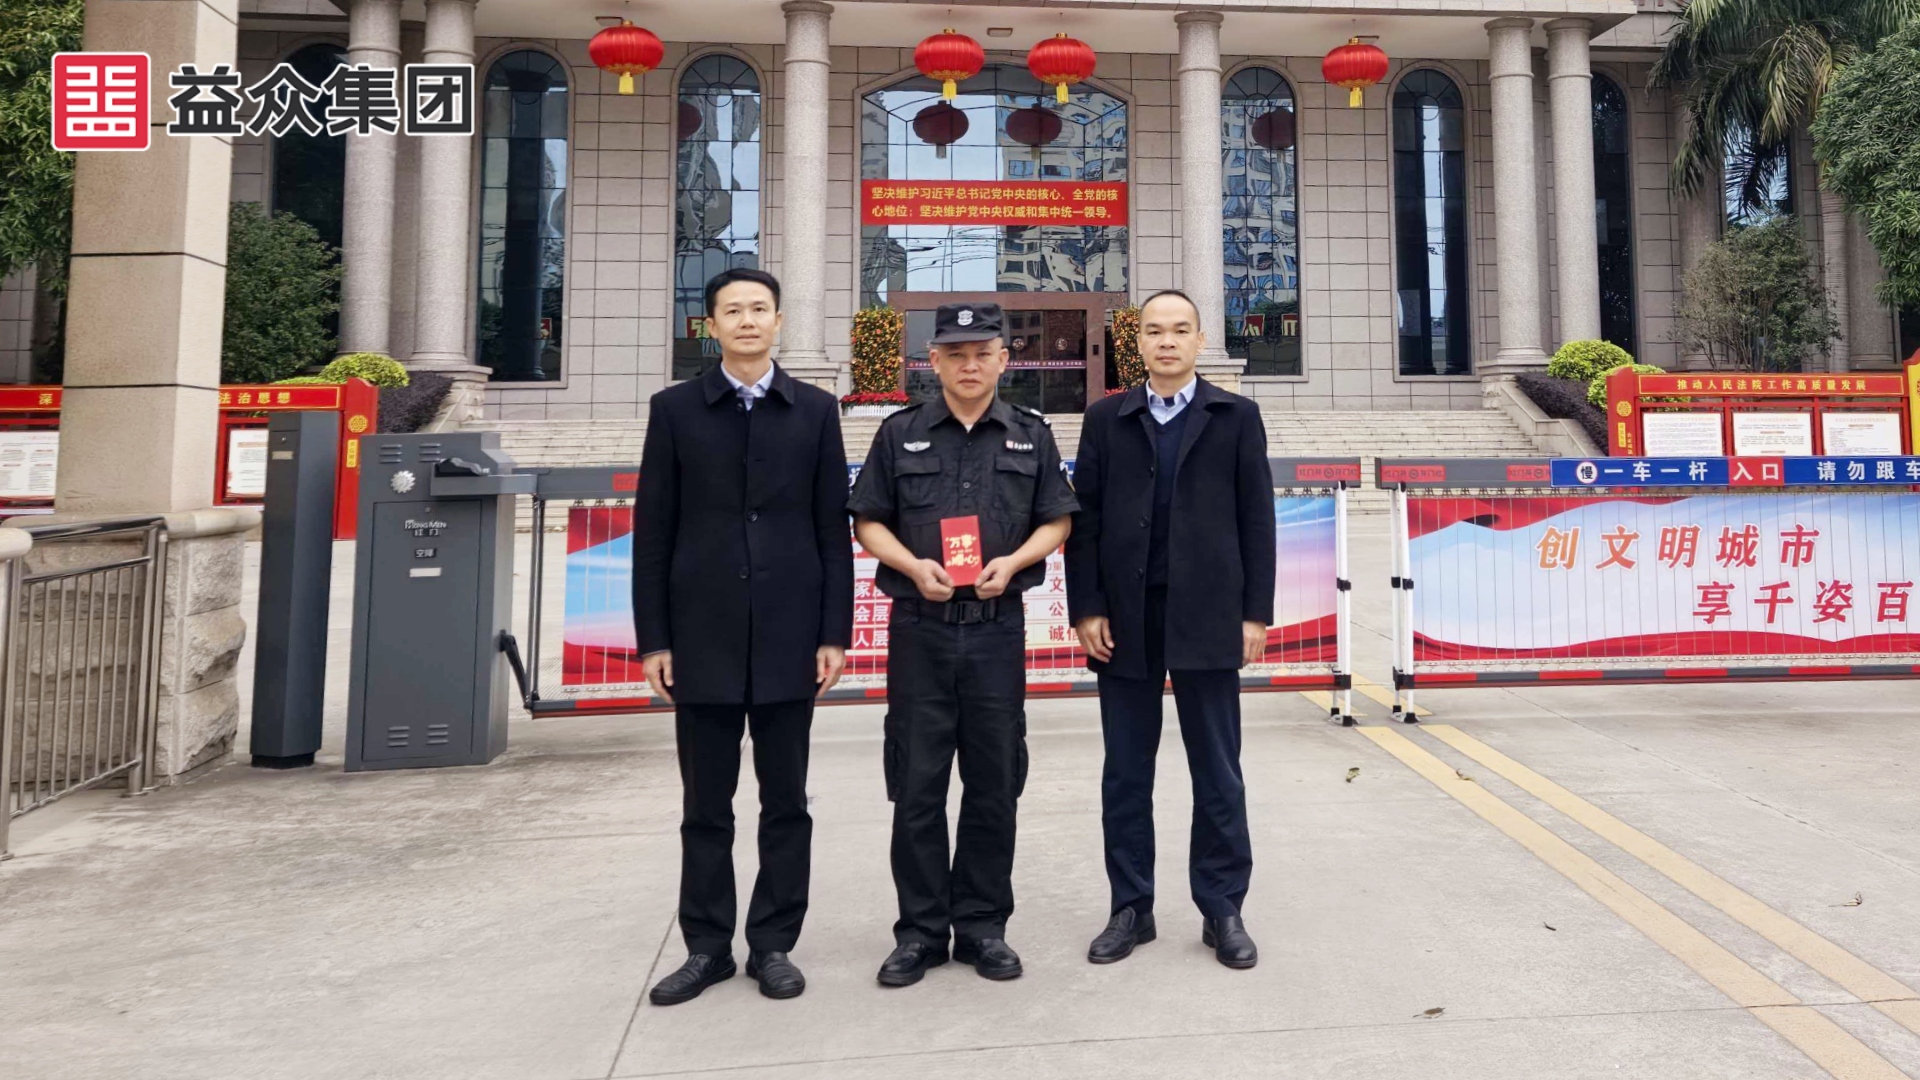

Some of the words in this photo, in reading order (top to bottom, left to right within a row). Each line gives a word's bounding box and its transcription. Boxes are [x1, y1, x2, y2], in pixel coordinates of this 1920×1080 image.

[871, 187, 1118, 201] 坚决维护习近平总书记党中央的核心、全党的核
[1677, 378, 1867, 392] 推动人民法院工作高质量发展
[39, 393, 53, 405] 深
[1581, 466, 1593, 480] 慢
[1604, 461, 1709, 481] 一车一杆
[1732, 462, 1780, 481] 入口
[1816, 460, 1920, 481] 请勿跟车
[1536, 524, 1820, 570] 创文明城市
[1693, 580, 1914, 624] 享千姿百
